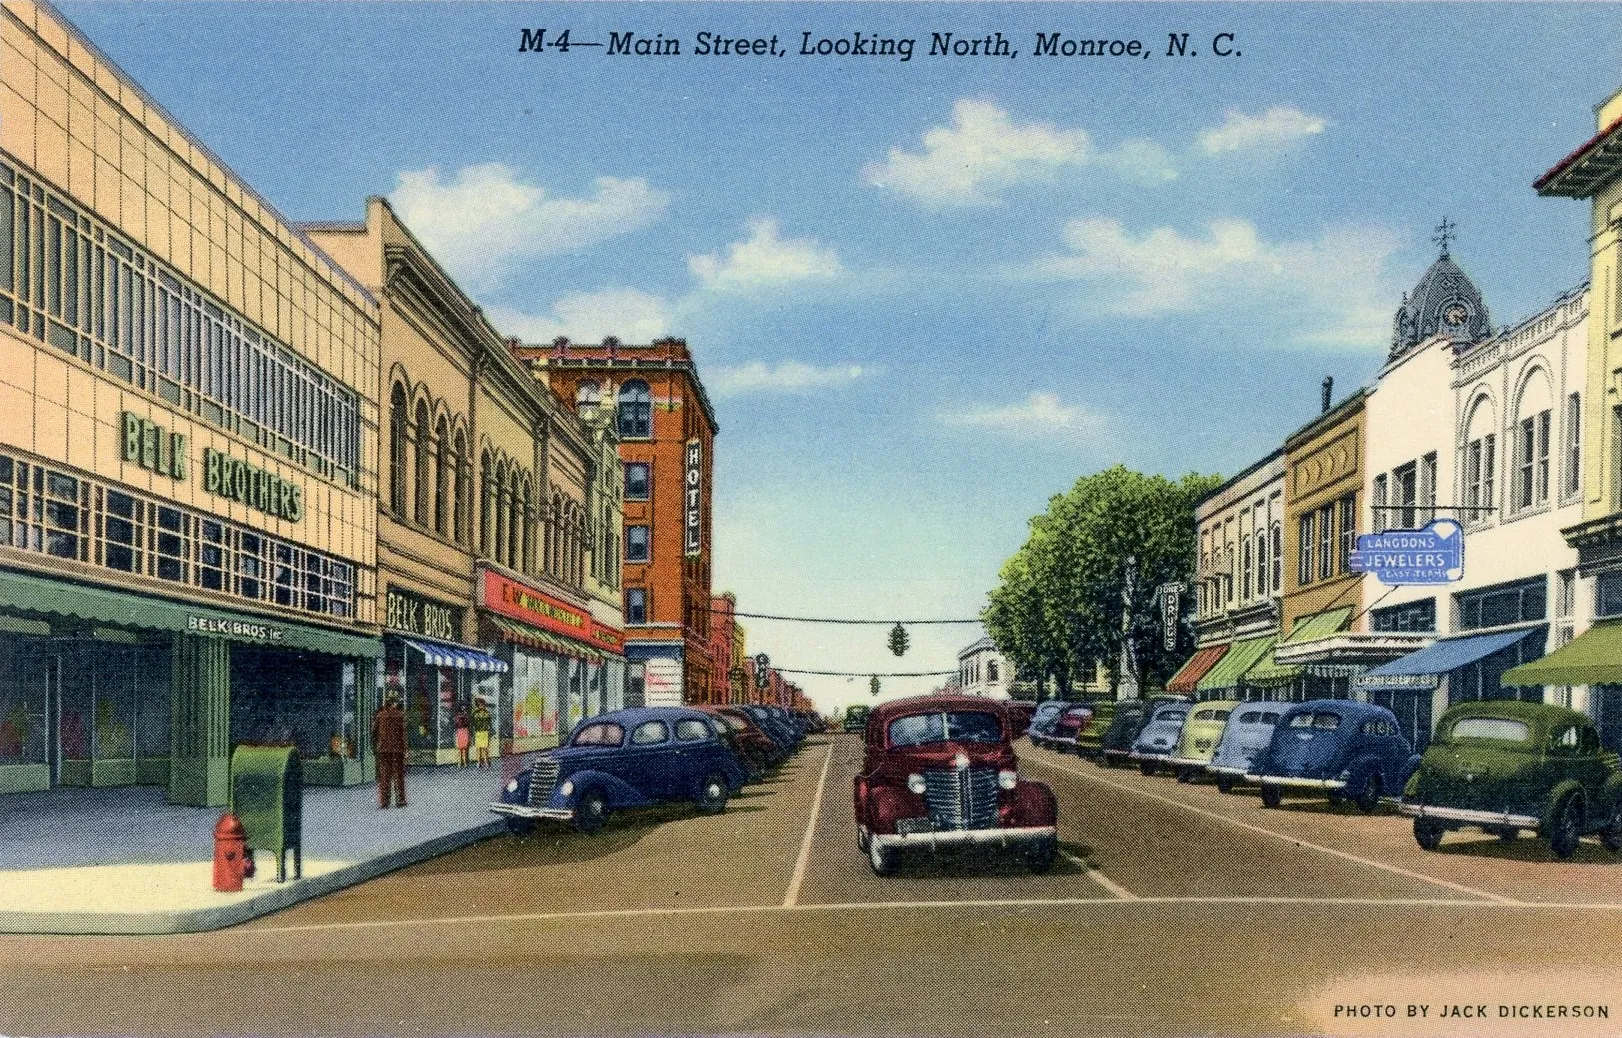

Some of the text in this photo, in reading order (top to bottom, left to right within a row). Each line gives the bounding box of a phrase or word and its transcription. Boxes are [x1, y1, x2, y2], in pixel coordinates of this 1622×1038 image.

[120, 411, 303, 524] BELK BROTHERS
[688, 448, 700, 548] HOTEL
[1367, 537, 1436, 549] LANGDONS
[1365, 554, 1446, 568] JEWELERS
[187, 615, 229, 634] BELK
[387, 591, 420, 633] BELK
